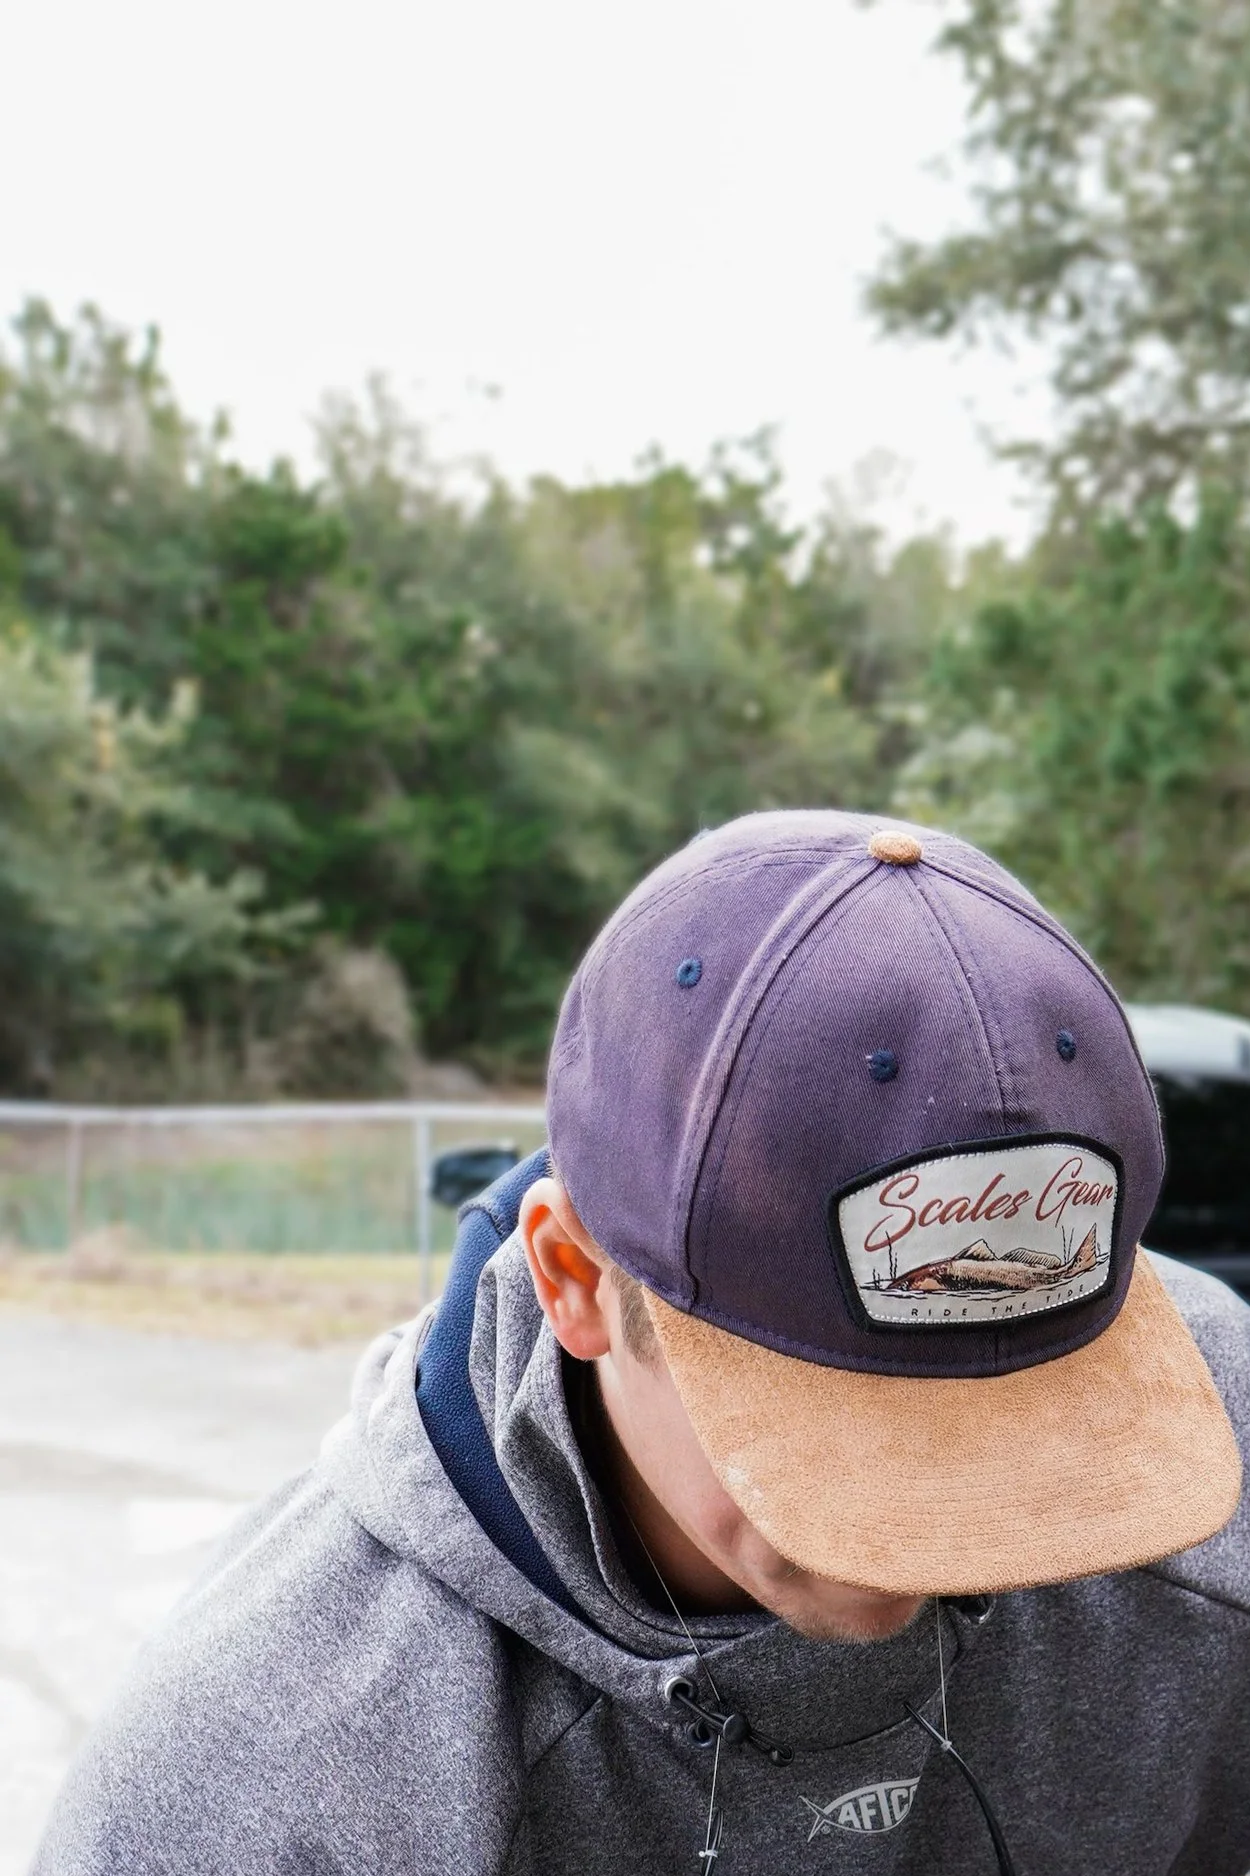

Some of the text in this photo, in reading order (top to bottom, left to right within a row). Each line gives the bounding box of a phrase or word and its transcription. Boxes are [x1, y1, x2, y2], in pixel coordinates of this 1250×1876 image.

[863, 1156, 1115, 1253] Scales Gear
[911, 1284, 1084, 1317] RIDE THE TIDE
